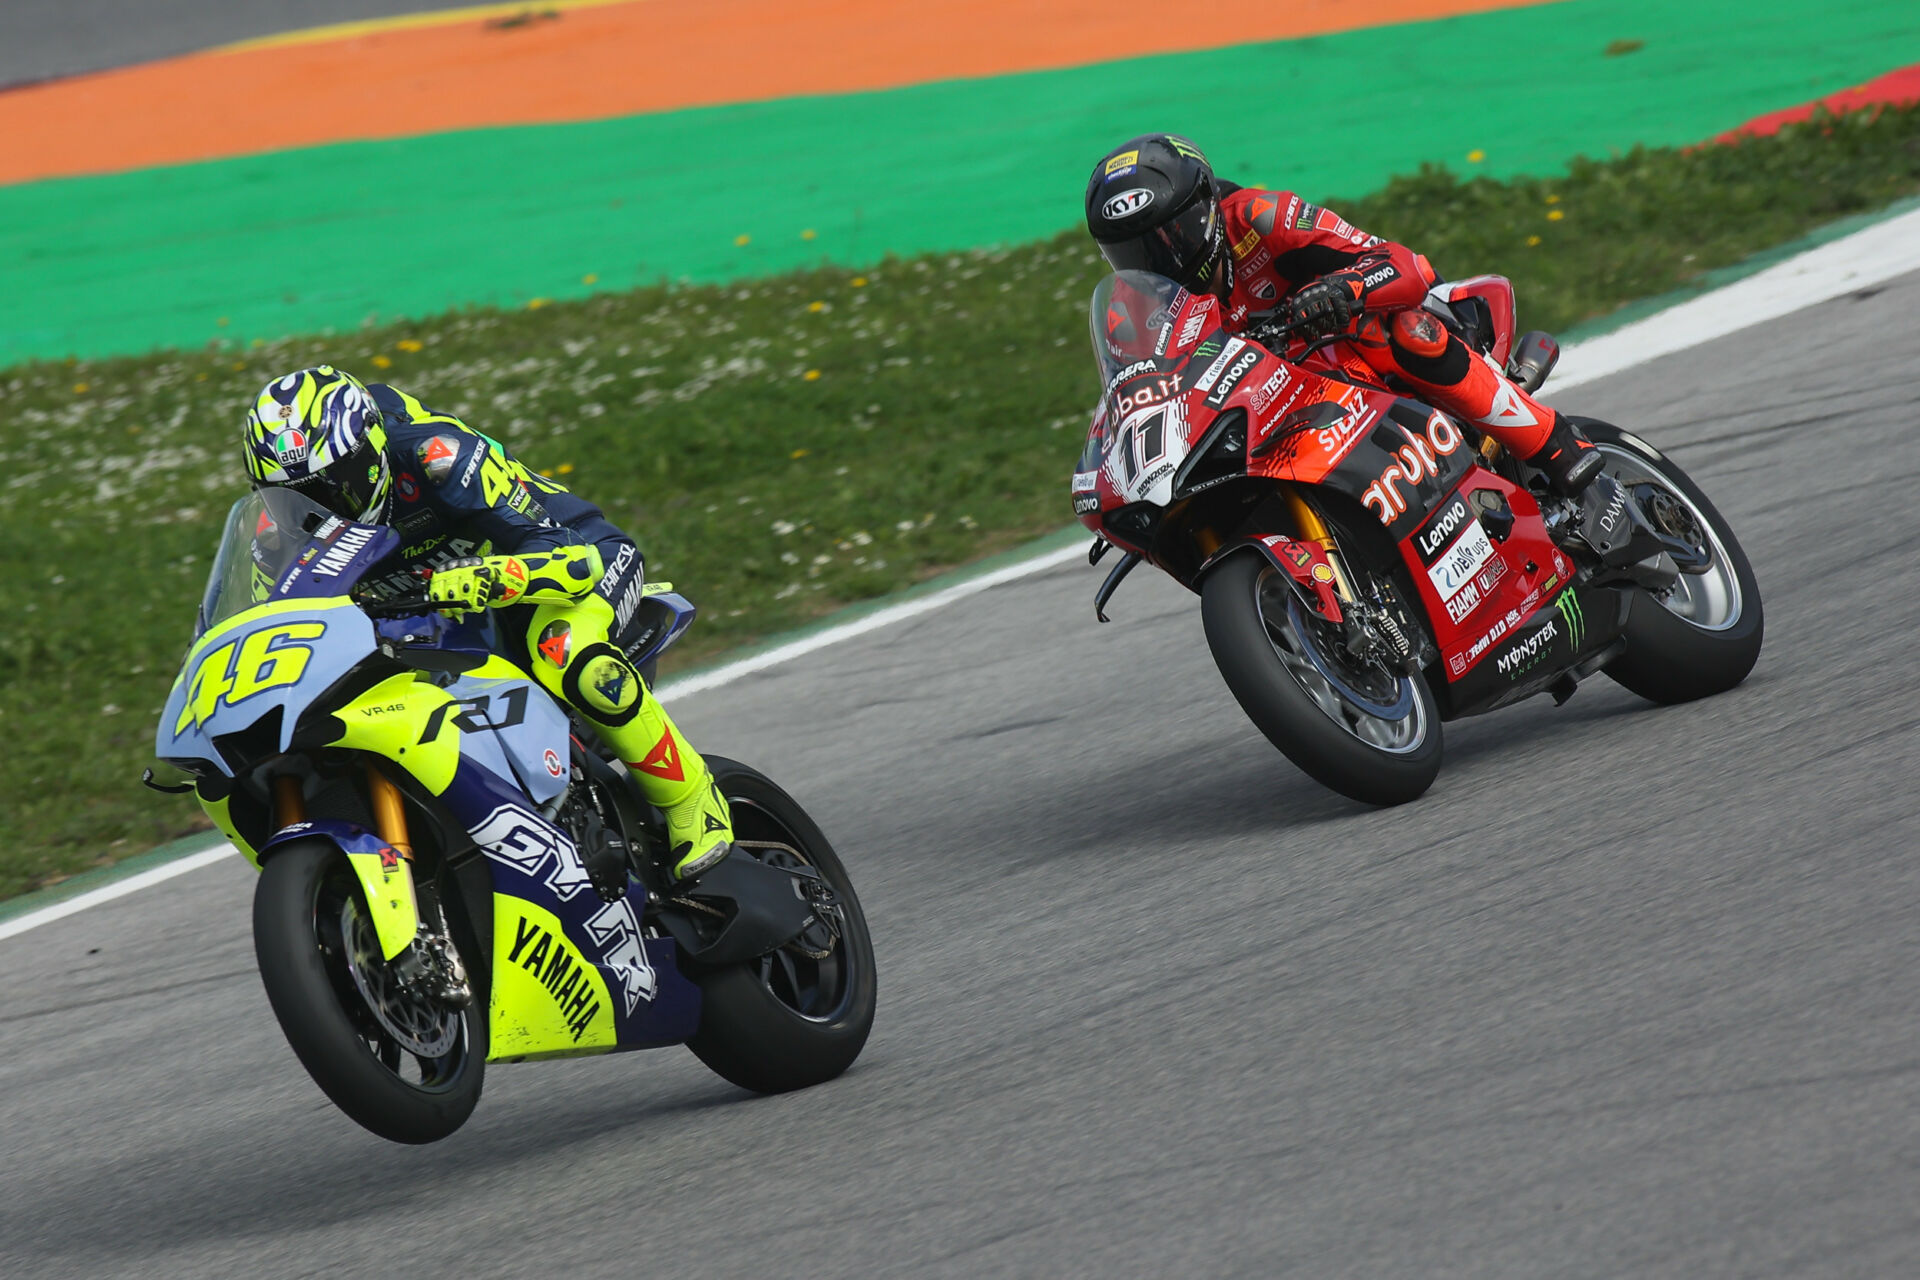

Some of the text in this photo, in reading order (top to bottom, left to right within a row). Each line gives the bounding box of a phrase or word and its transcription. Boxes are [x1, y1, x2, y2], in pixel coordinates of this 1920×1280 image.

[1107, 192, 1145, 218] KYT
[1364, 266, 1394, 288] enovo
[1208, 352, 1257, 405] Lenovo
[1250, 364, 1289, 411] SATECH
[1260, 393, 1296, 436] PANICALE
[460, 439, 487, 488] DAINESE
[1361, 408, 1463, 527] aruba
[311, 527, 377, 577] YAMAHA
[1418, 500, 1466, 556] Lenovo
[280, 567, 302, 595] GYTR
[616, 560, 644, 639] YAMAH
[1445, 581, 1480, 622] FIAMM
[173, 620, 327, 743] 46
[508, 916, 600, 1043] YAMAHA
